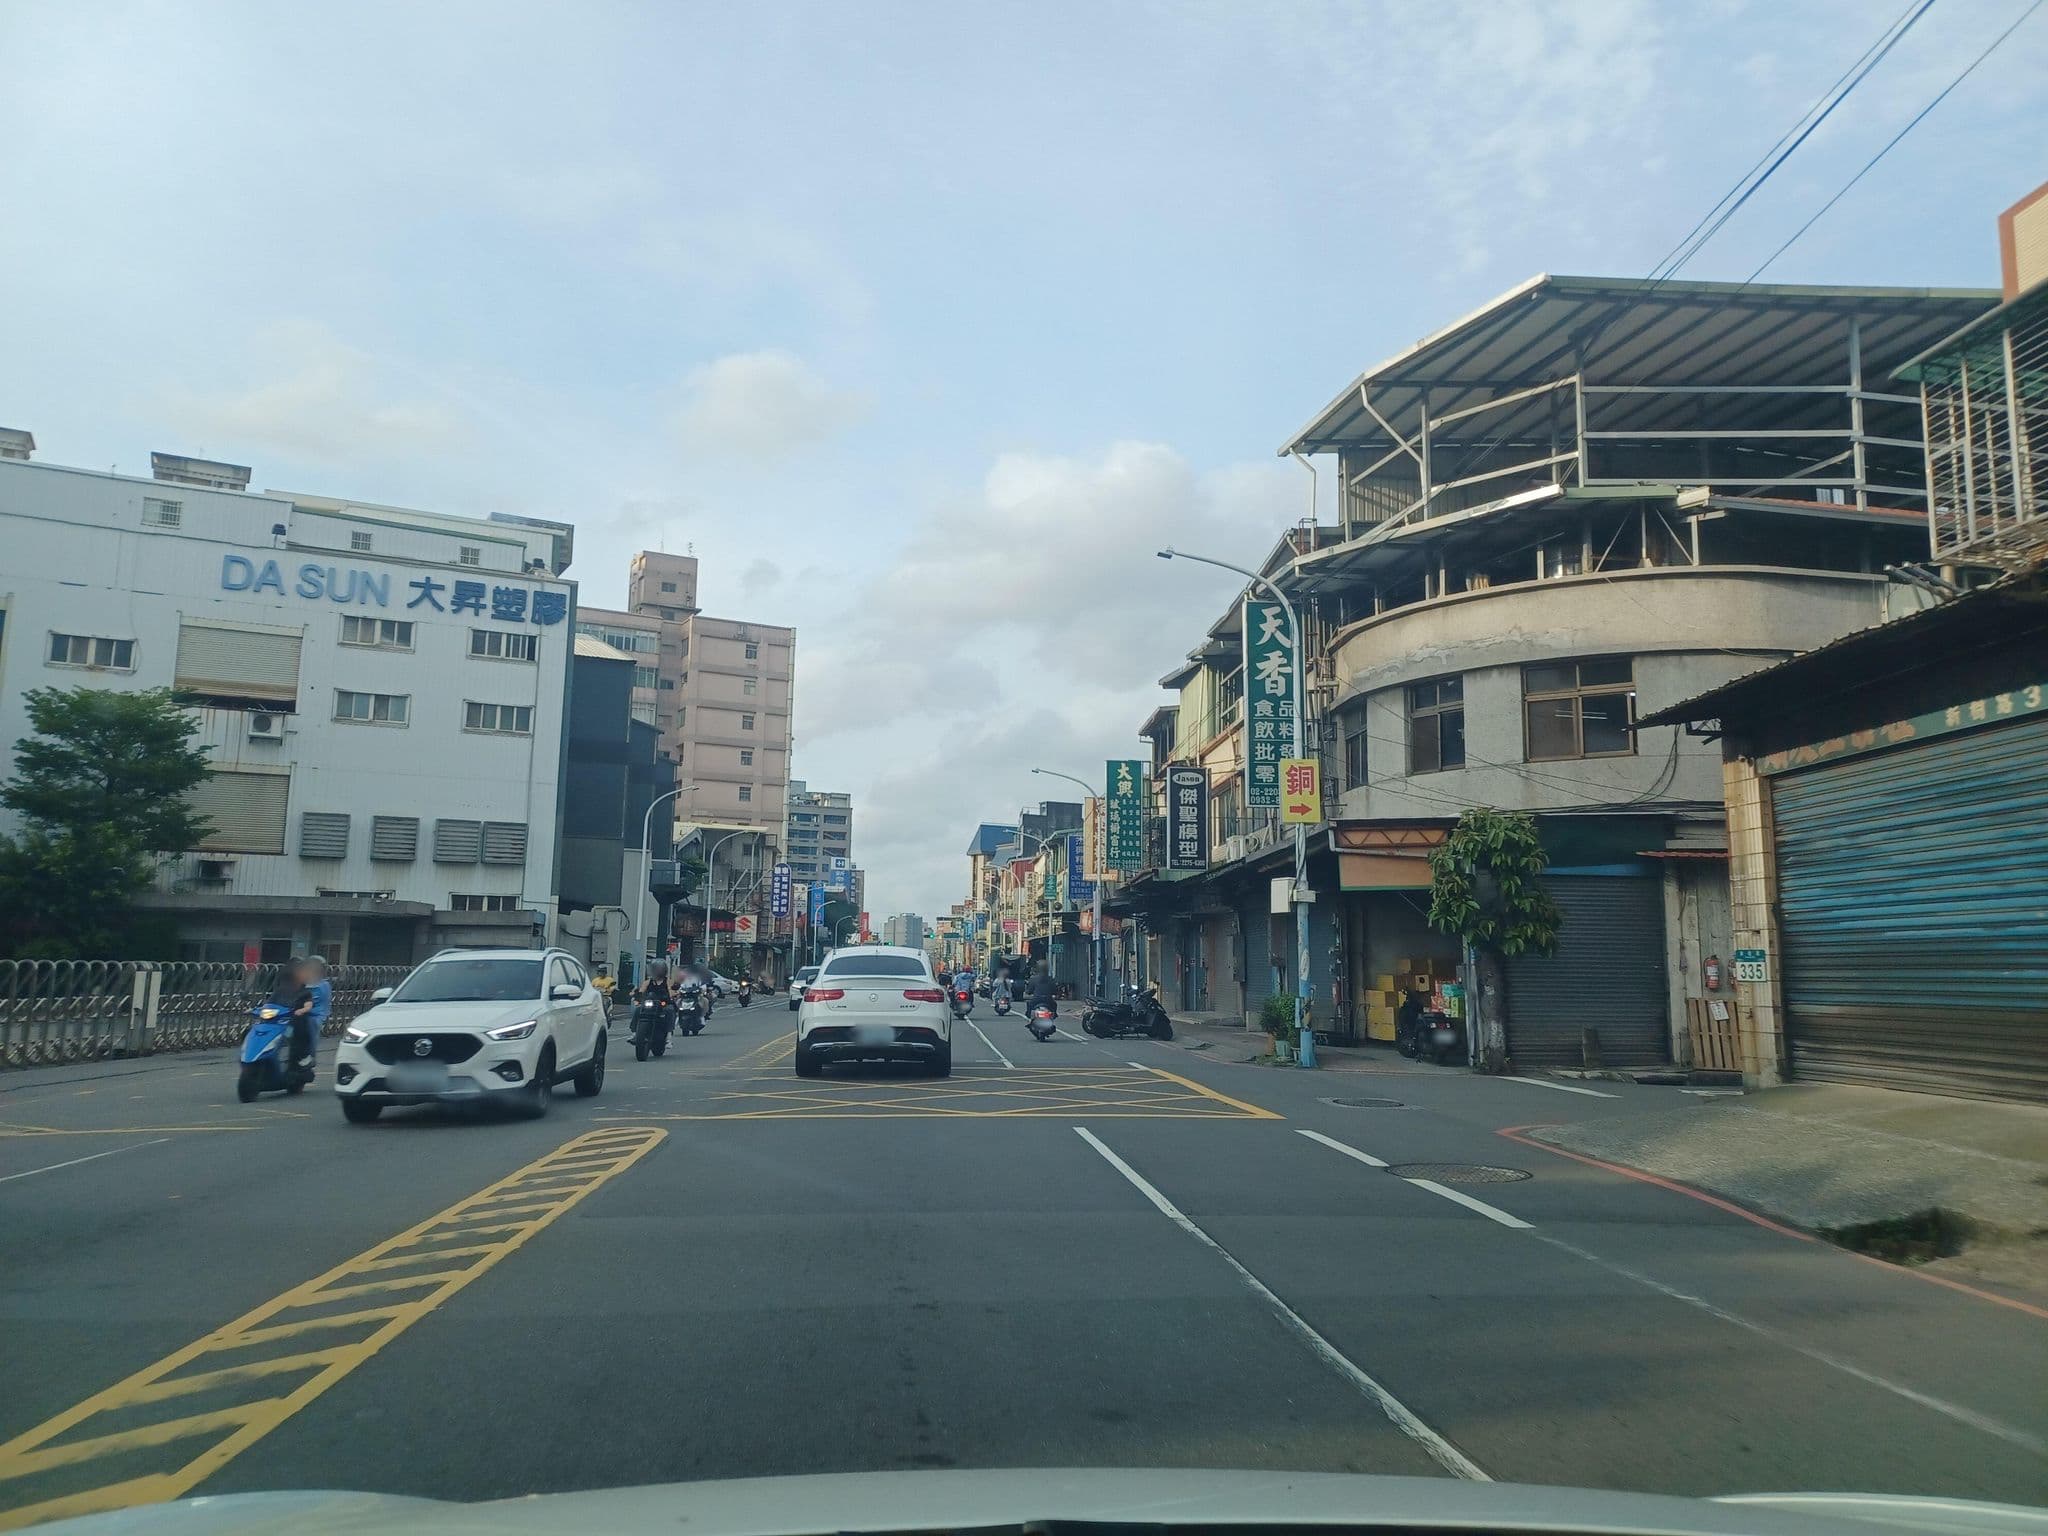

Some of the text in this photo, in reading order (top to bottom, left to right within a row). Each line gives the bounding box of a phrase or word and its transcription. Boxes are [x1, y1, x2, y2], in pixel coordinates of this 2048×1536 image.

[222, 554, 567, 626] DA SUN 大昇塑膠
[1254, 606, 1292, 697] 天香
[1176, 774, 1200, 782] Jason
[1255, 765, 1275, 783] 零
[1286, 765, 1315, 796] 銅
[1250, 787, 1280, 796] 02-220
[1178, 788, 1198, 858] 傑聖模型
[1740, 963, 1763, 979] 335
